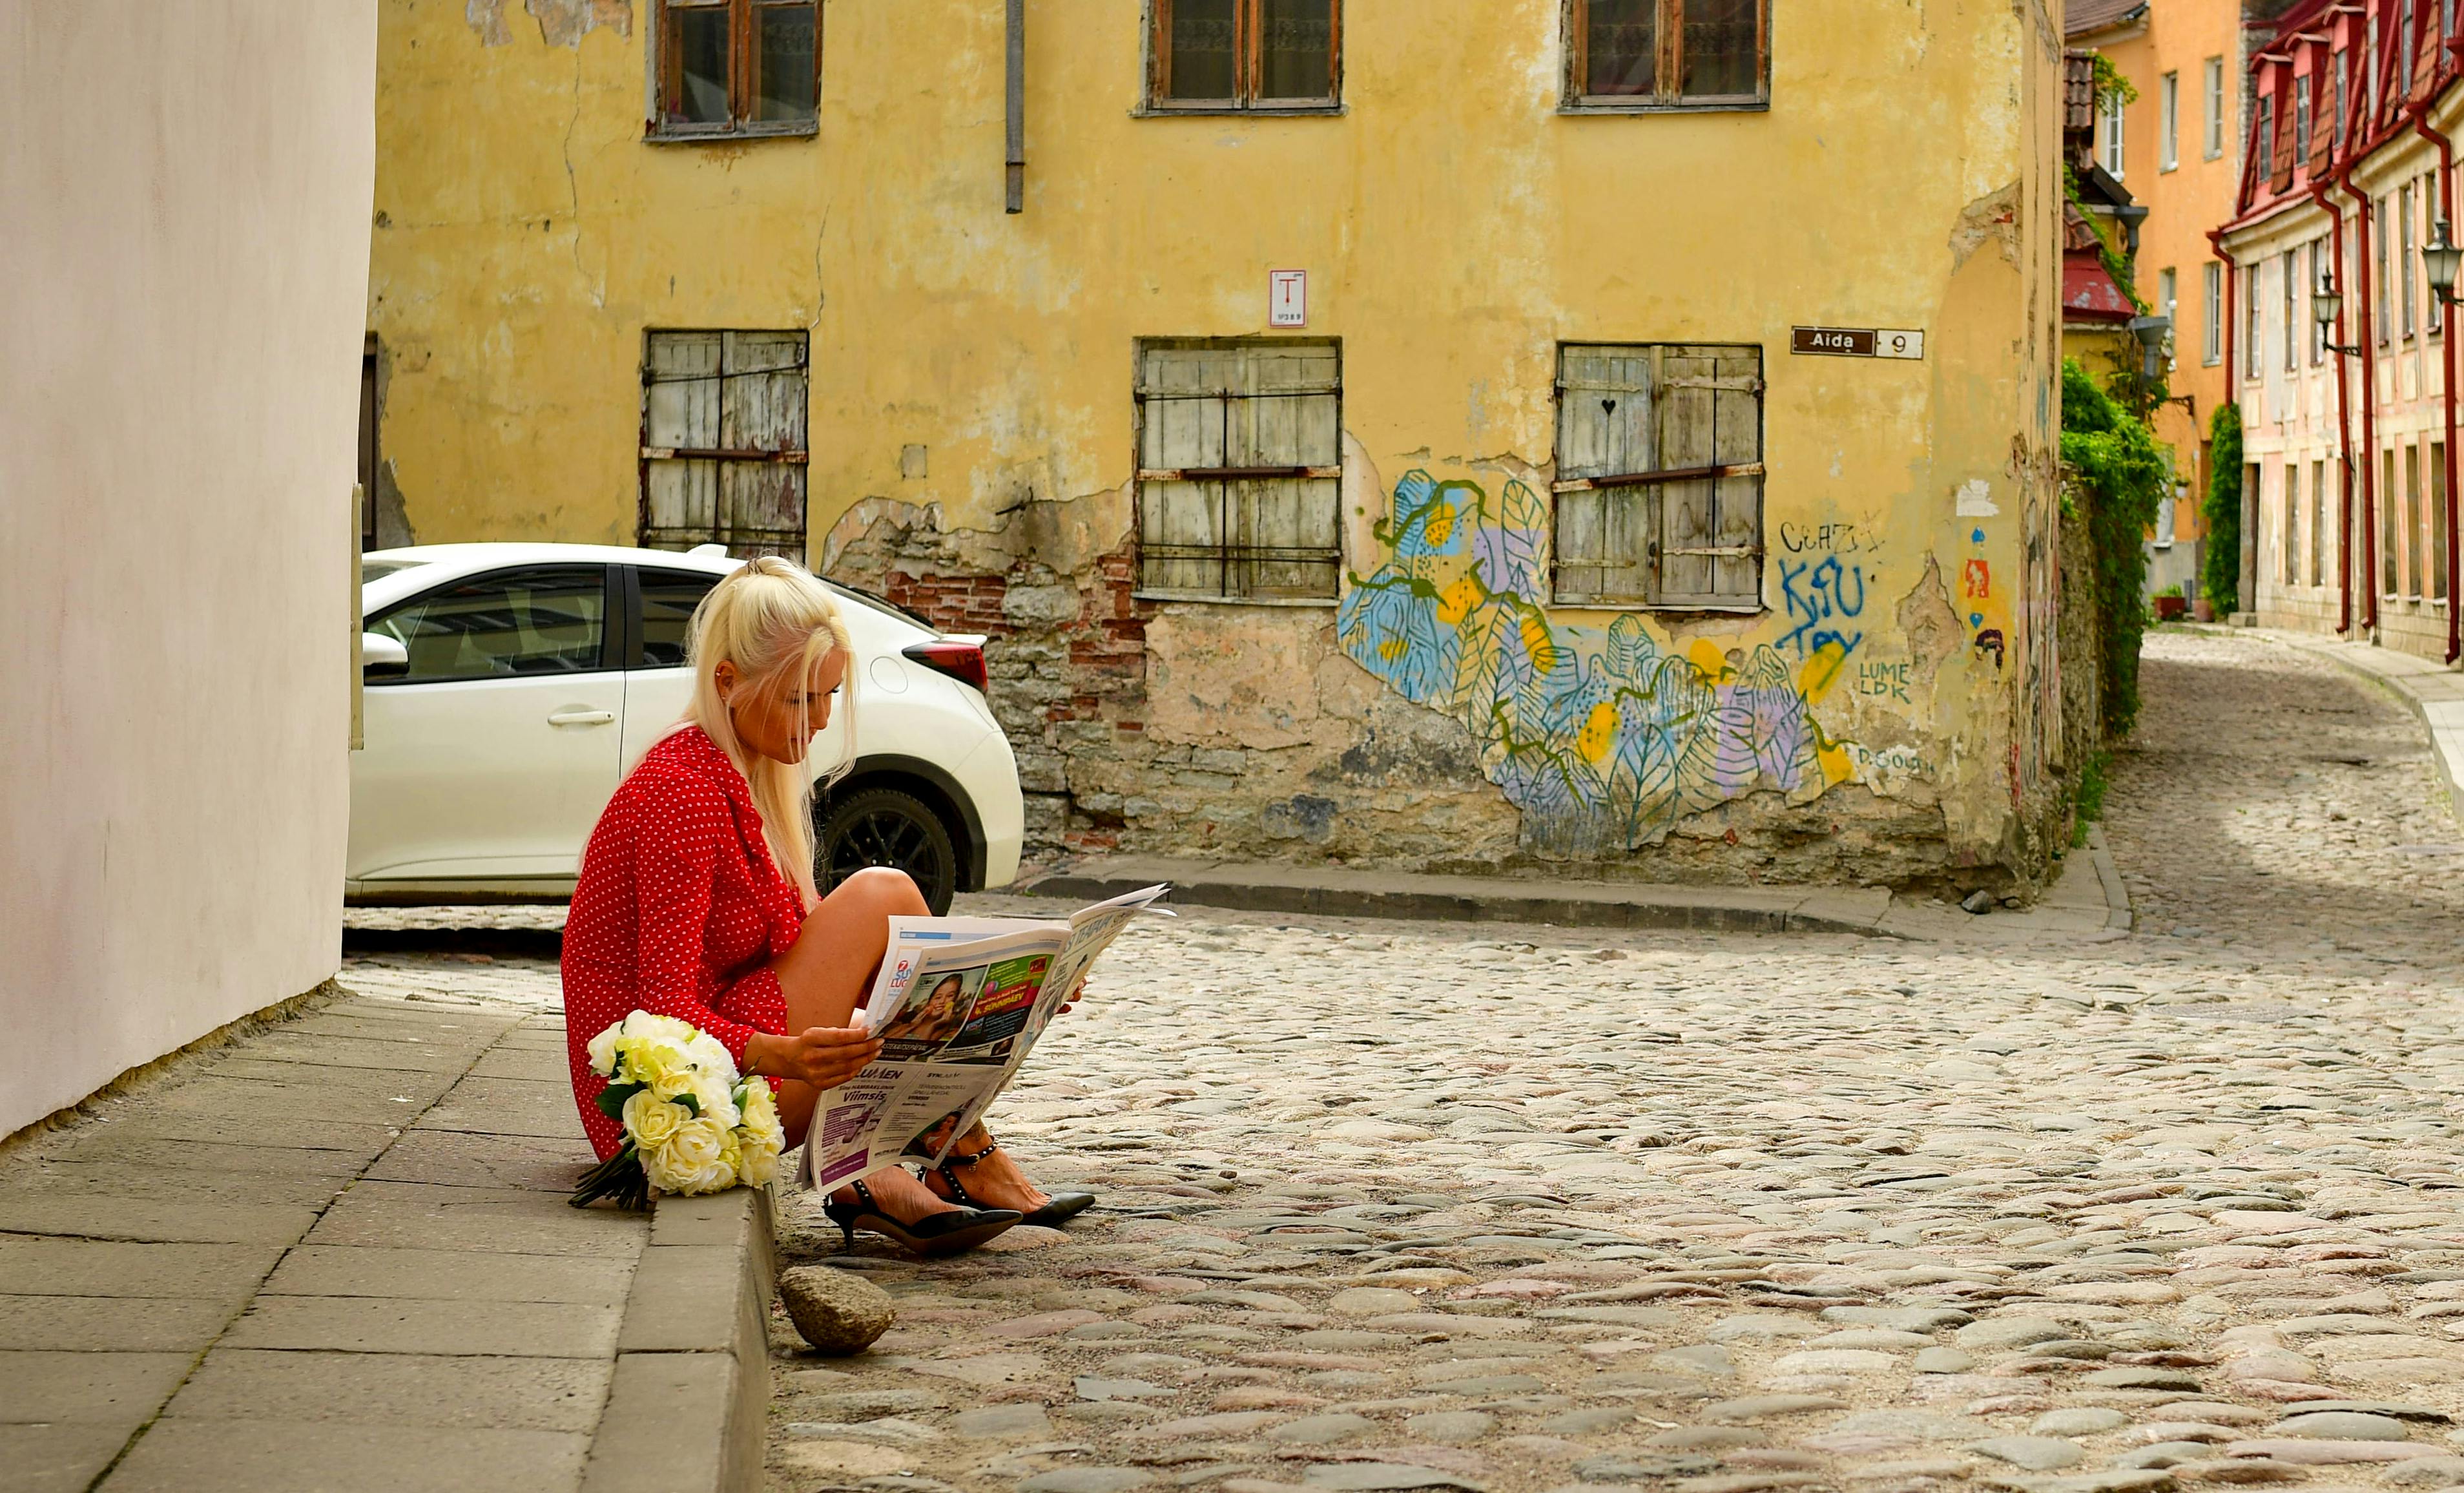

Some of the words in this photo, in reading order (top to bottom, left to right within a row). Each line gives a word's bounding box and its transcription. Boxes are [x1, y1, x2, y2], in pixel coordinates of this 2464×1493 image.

[1813, 333, 1854, 348] Aida
[1892, 335, 1906, 353] 9
[1859, 662, 1910, 685] LUME
[1860, 680, 1912, 704] LDK
[844, 1091, 887, 1102] Viimsis
